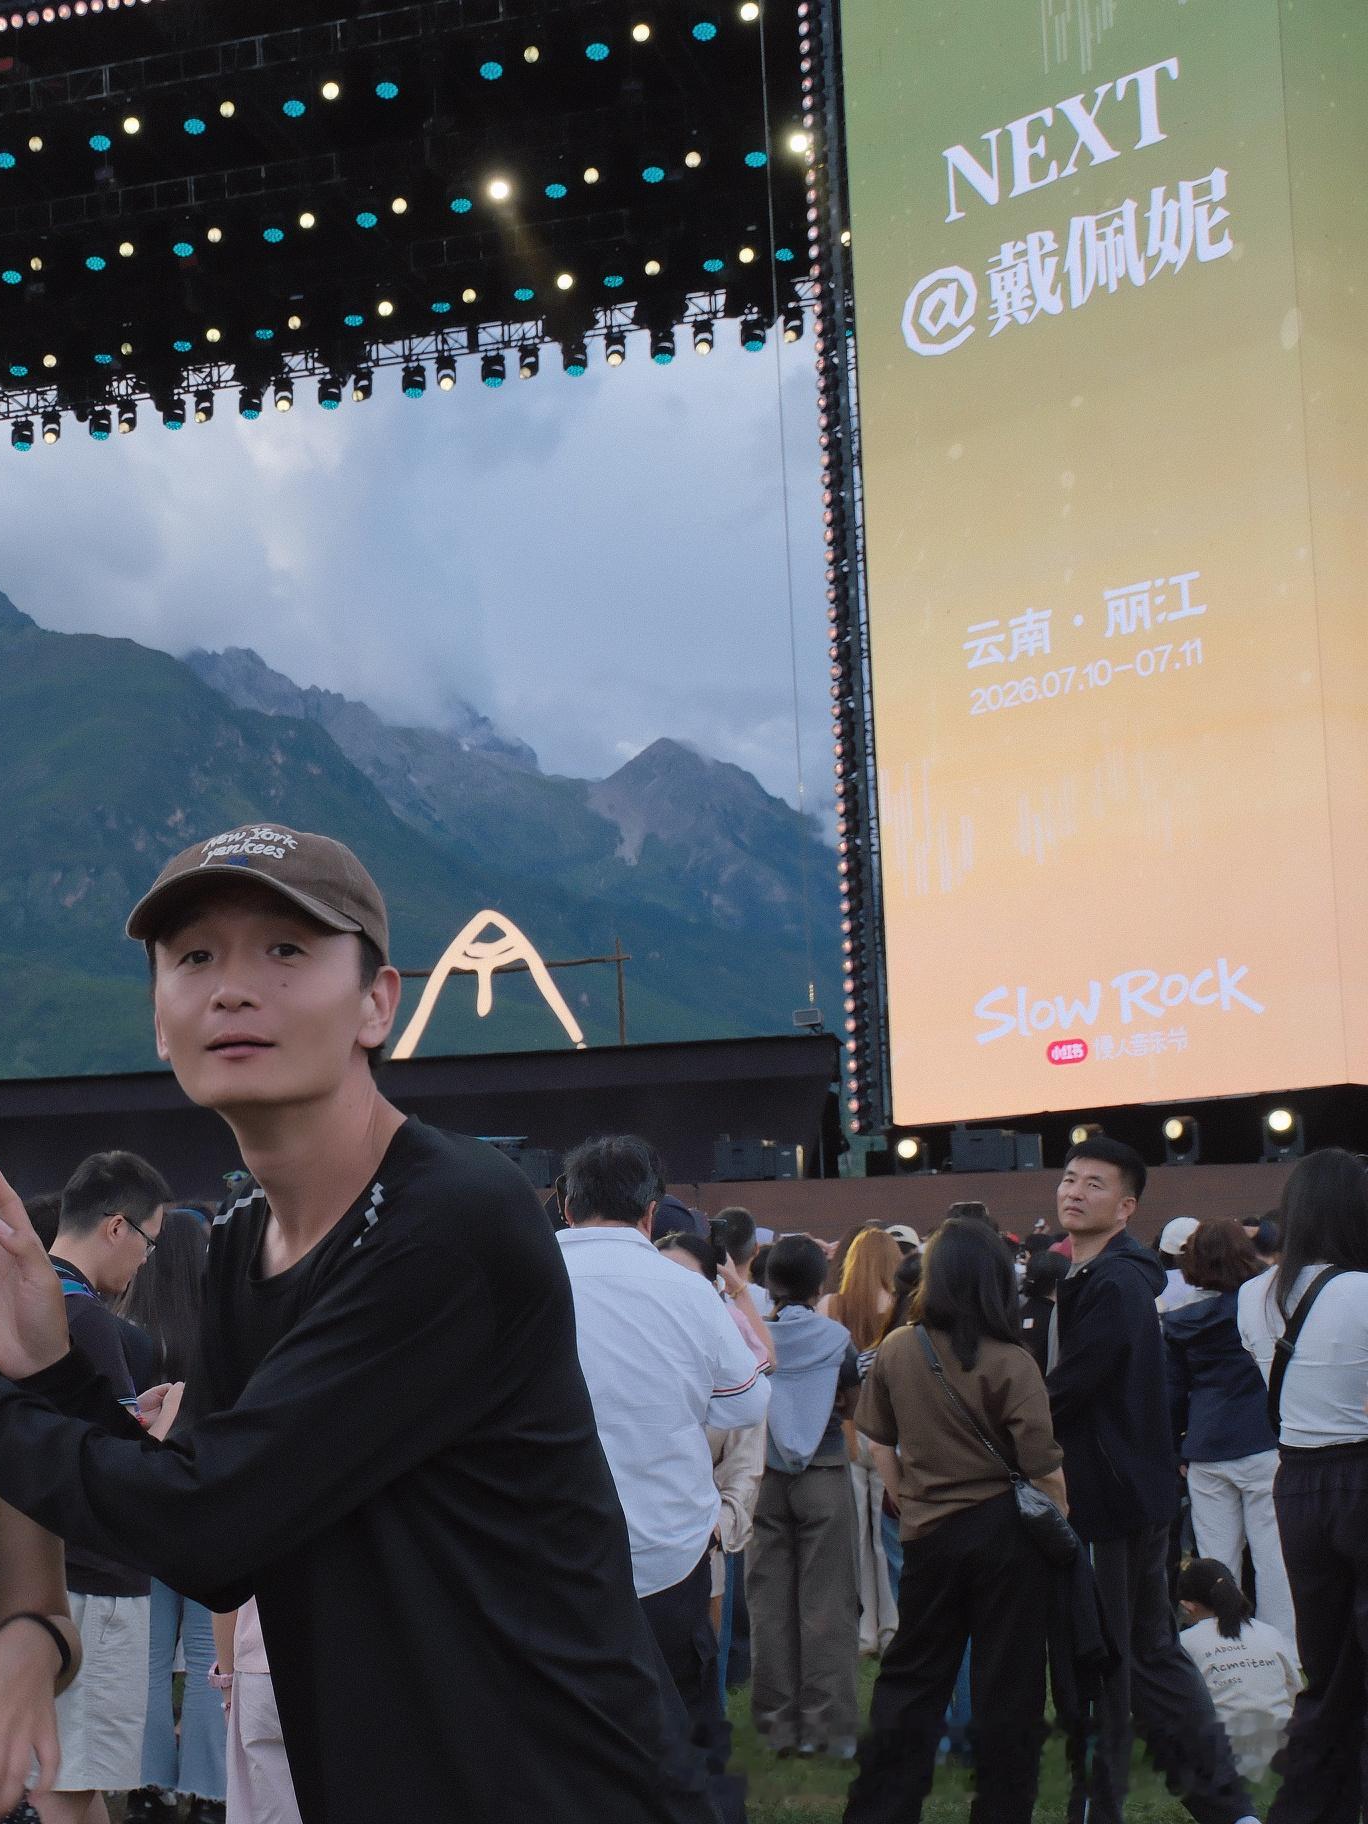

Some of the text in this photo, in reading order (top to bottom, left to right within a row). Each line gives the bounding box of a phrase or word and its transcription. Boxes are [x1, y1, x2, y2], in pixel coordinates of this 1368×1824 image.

[942, 56, 1179, 223] NEXT
[900, 167, 1234, 357] @戴佩妮
[201, 827, 298, 853] New York
